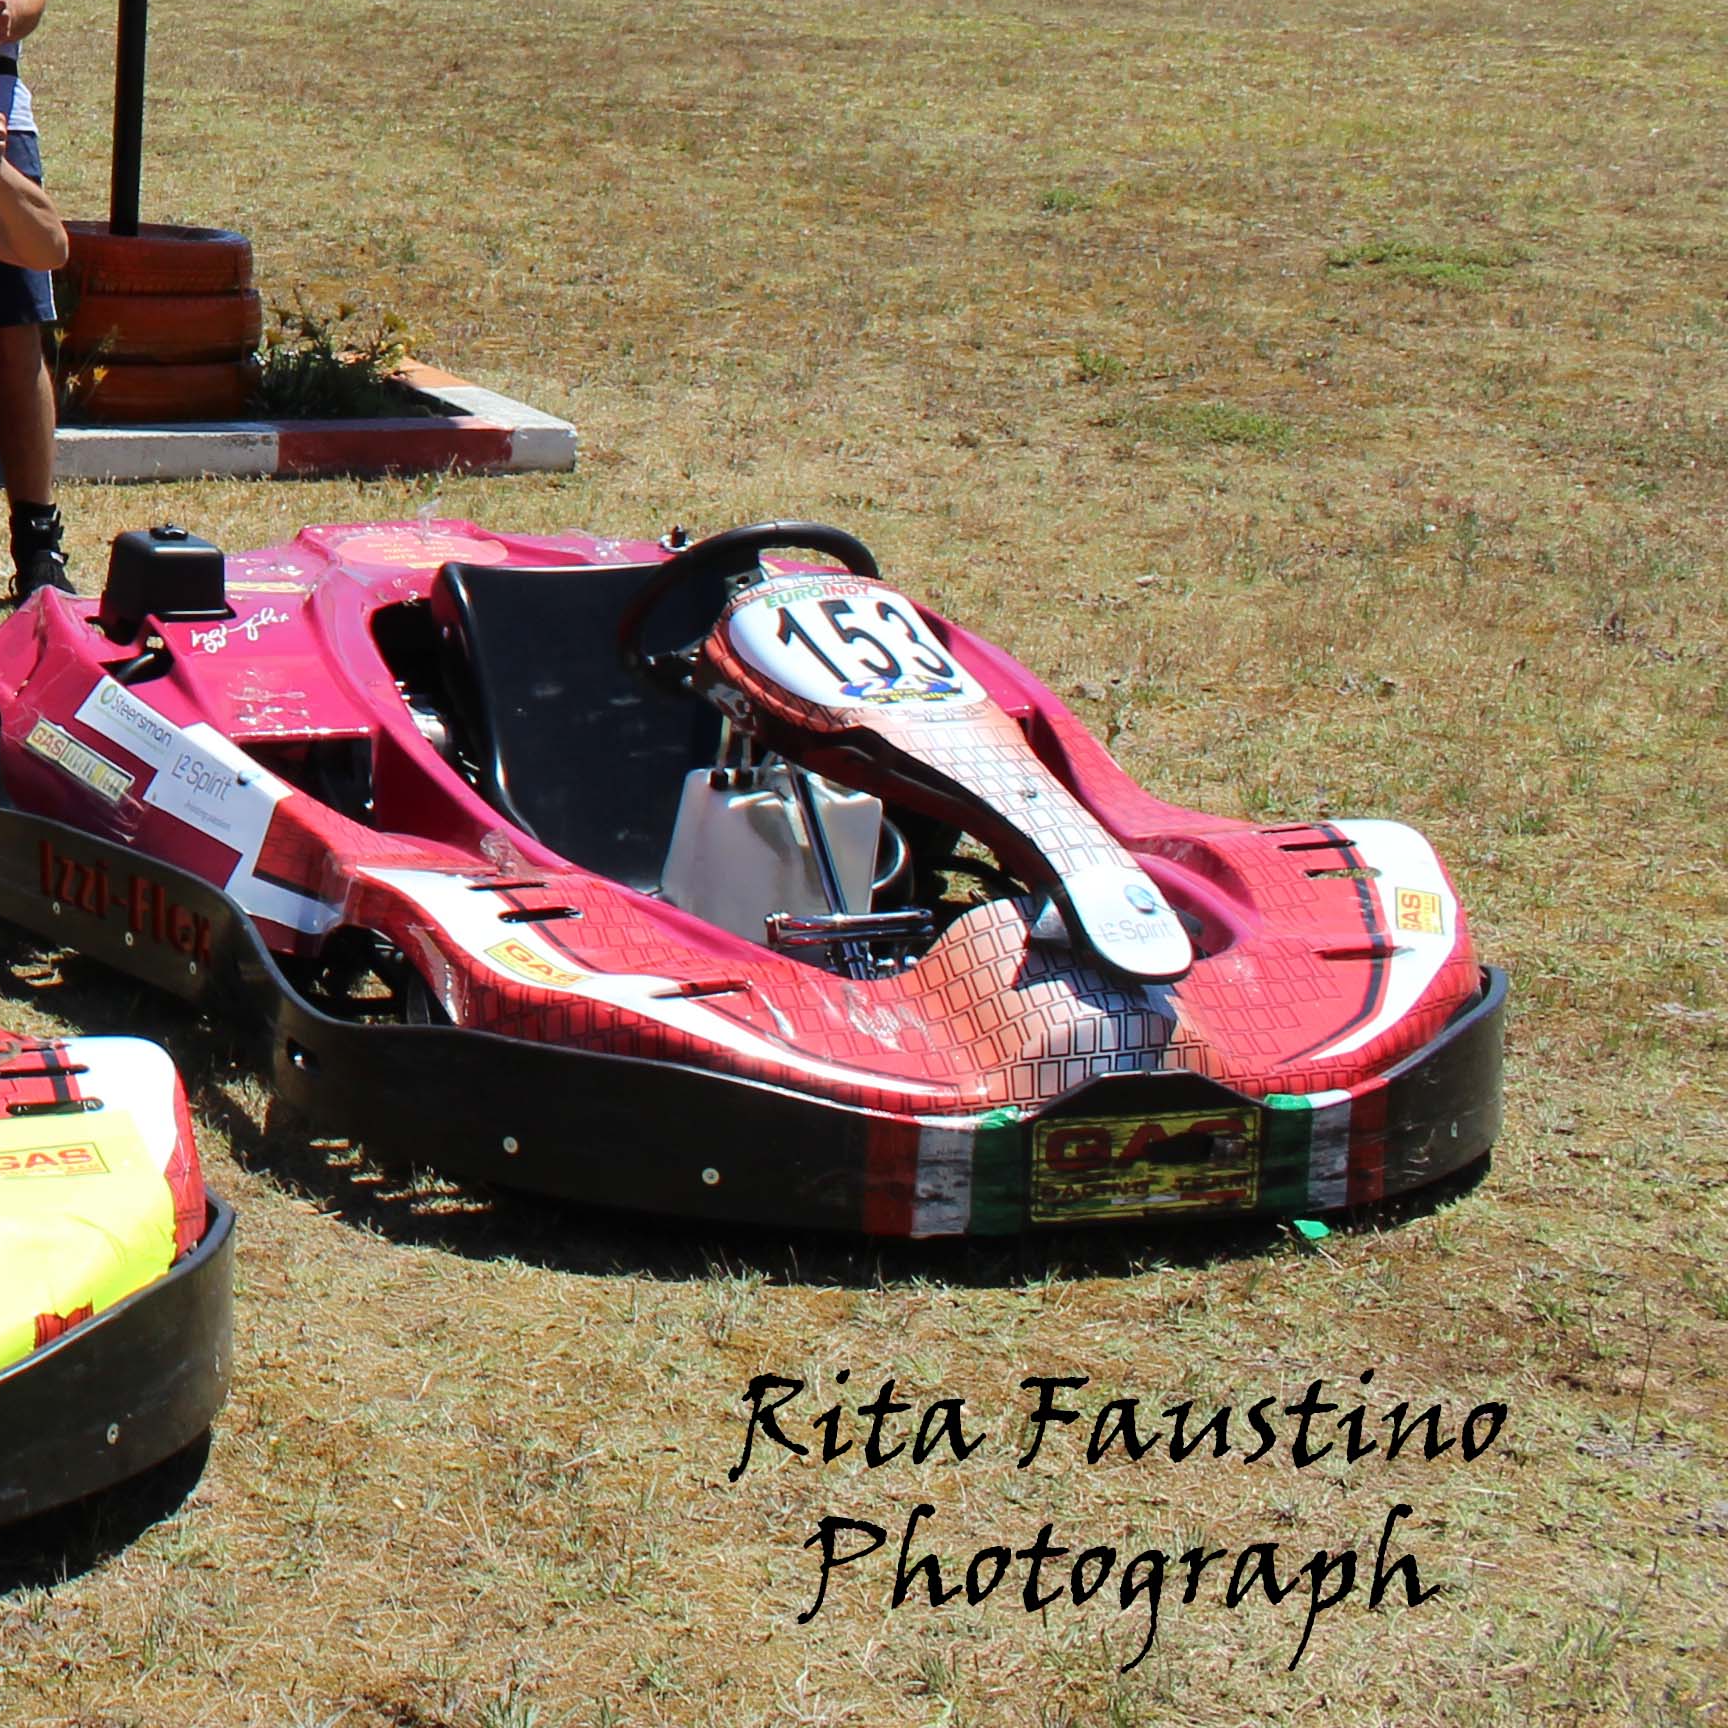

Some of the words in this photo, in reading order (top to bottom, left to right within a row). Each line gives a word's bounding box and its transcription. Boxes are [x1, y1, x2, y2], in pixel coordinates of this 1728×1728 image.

[763, 584, 871, 609] EUROINDY
[776, 598, 956, 683] 153
[110, 693, 173, 747] Steersman
[30, 727, 65, 759] GAS
[191, 761, 232, 801] Spirit
[1119, 919, 1171, 944] Spirit
[504, 944, 581, 985] GAS
